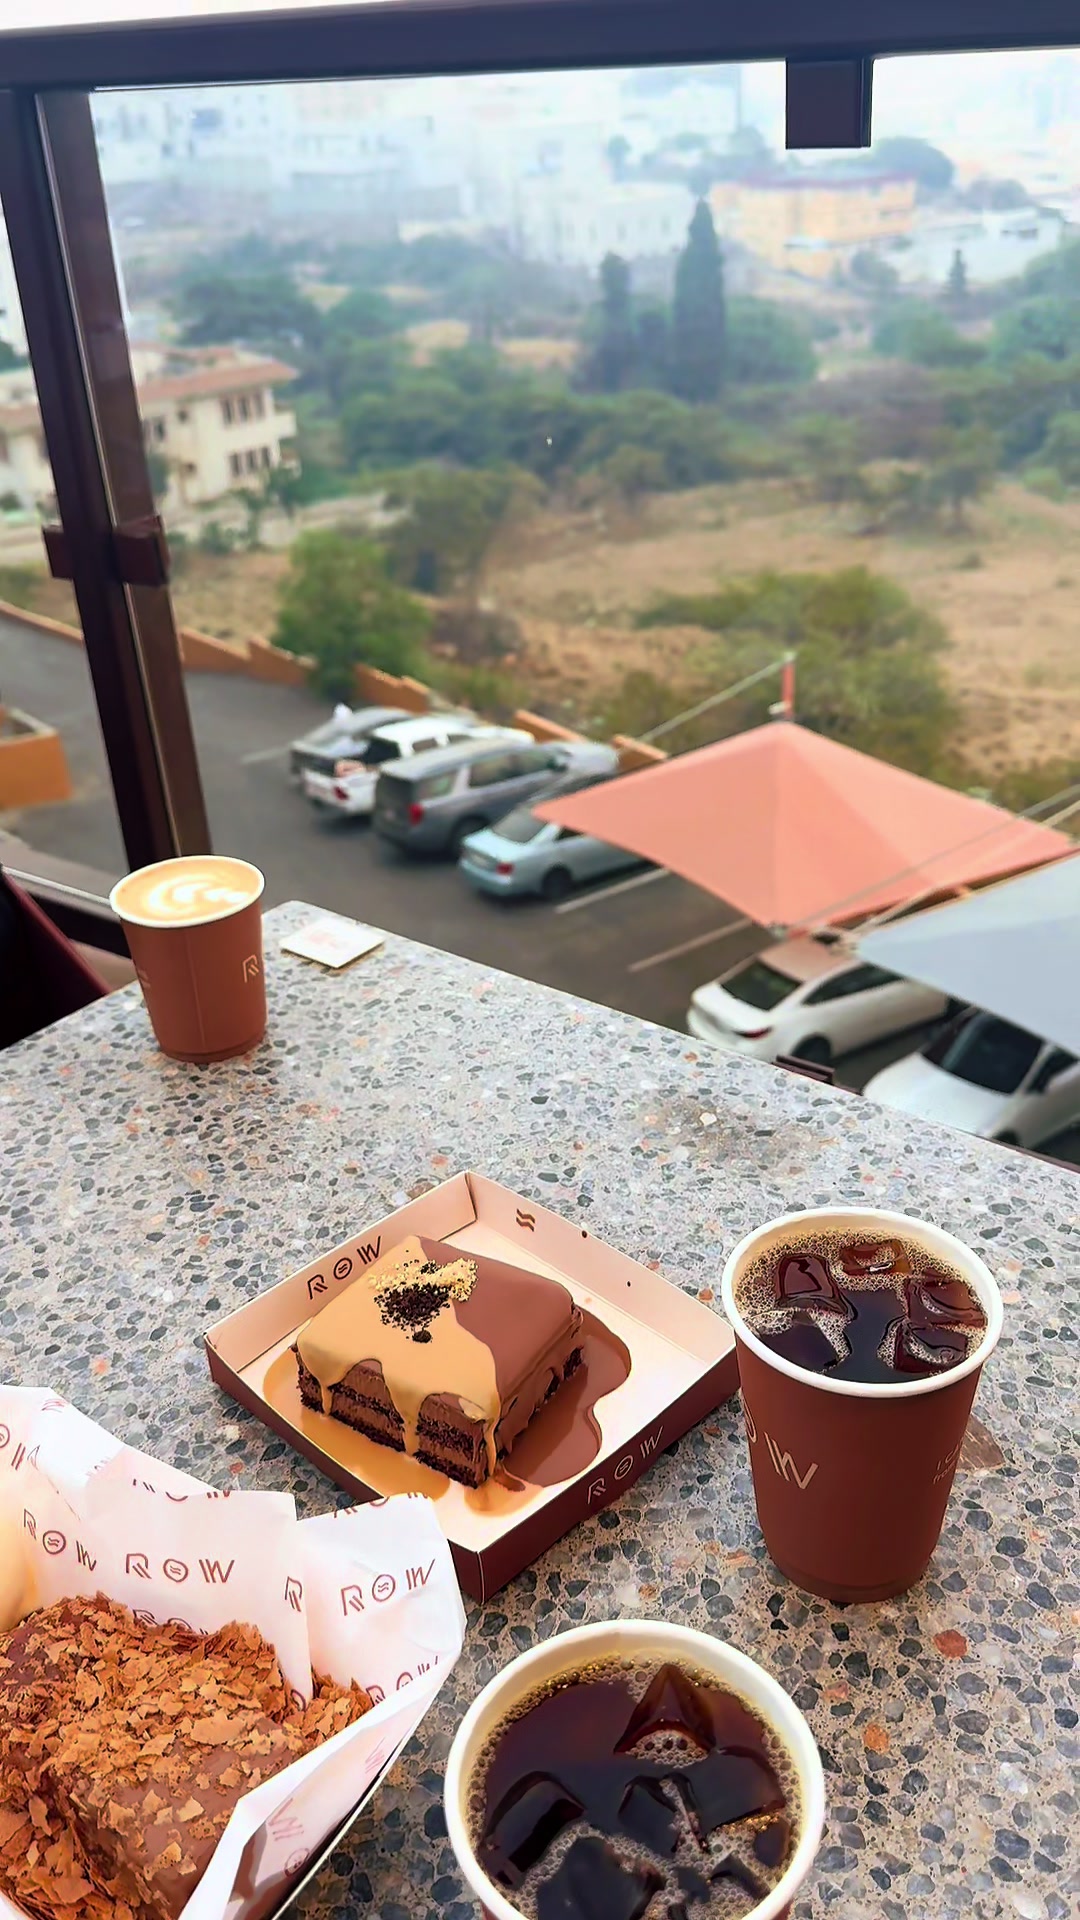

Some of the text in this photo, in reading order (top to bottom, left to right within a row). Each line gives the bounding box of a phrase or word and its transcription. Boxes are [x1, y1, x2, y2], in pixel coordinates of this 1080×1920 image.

[306, 1235, 382, 1300] ROW
[587, 1425, 664, 1505] ROW
[24, 1508, 97, 1571] ROW
[125, 1553, 235, 1584] ROW
[340, 1558, 436, 1616] ROW
